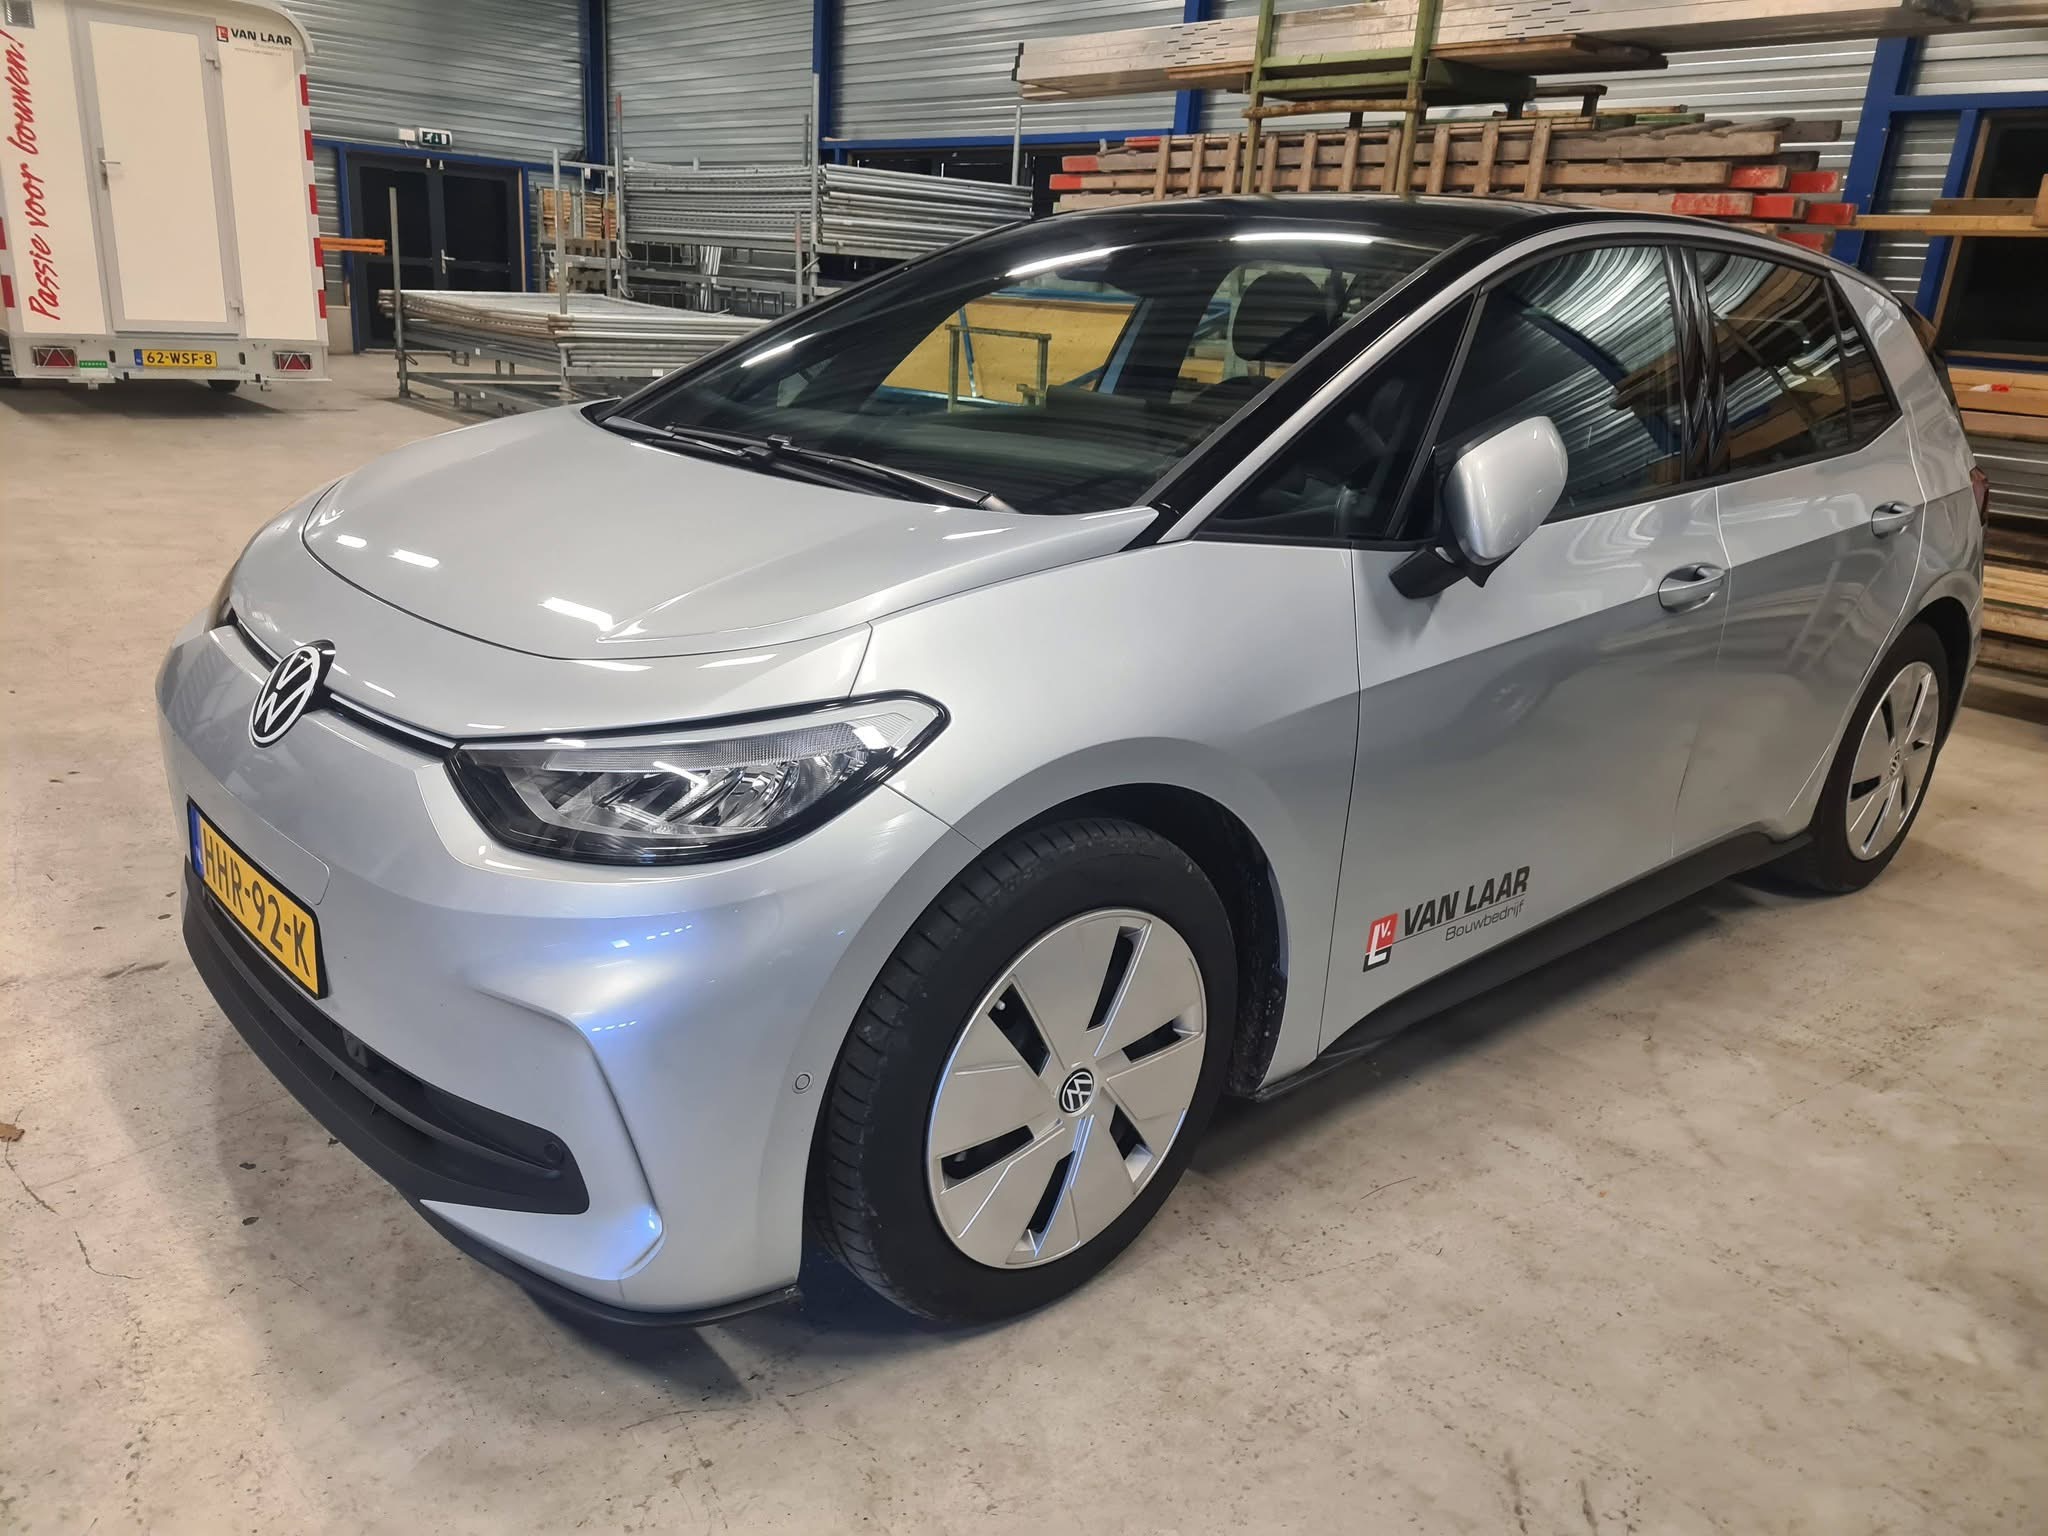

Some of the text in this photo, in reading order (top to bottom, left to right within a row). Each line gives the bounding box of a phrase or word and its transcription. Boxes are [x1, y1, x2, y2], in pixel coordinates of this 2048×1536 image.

[231, 28, 293, 46] VAN LAAR
[20, 163, 49, 228] voor
[28, 233, 61, 320] Passie
[147, 351, 212, 365] 62-WSF-8
[202, 825, 312, 978] HHR-92-K
[1404, 866, 1530, 936] VAN LAAR
[1445, 900, 1525, 941] Bouwbedrijf
